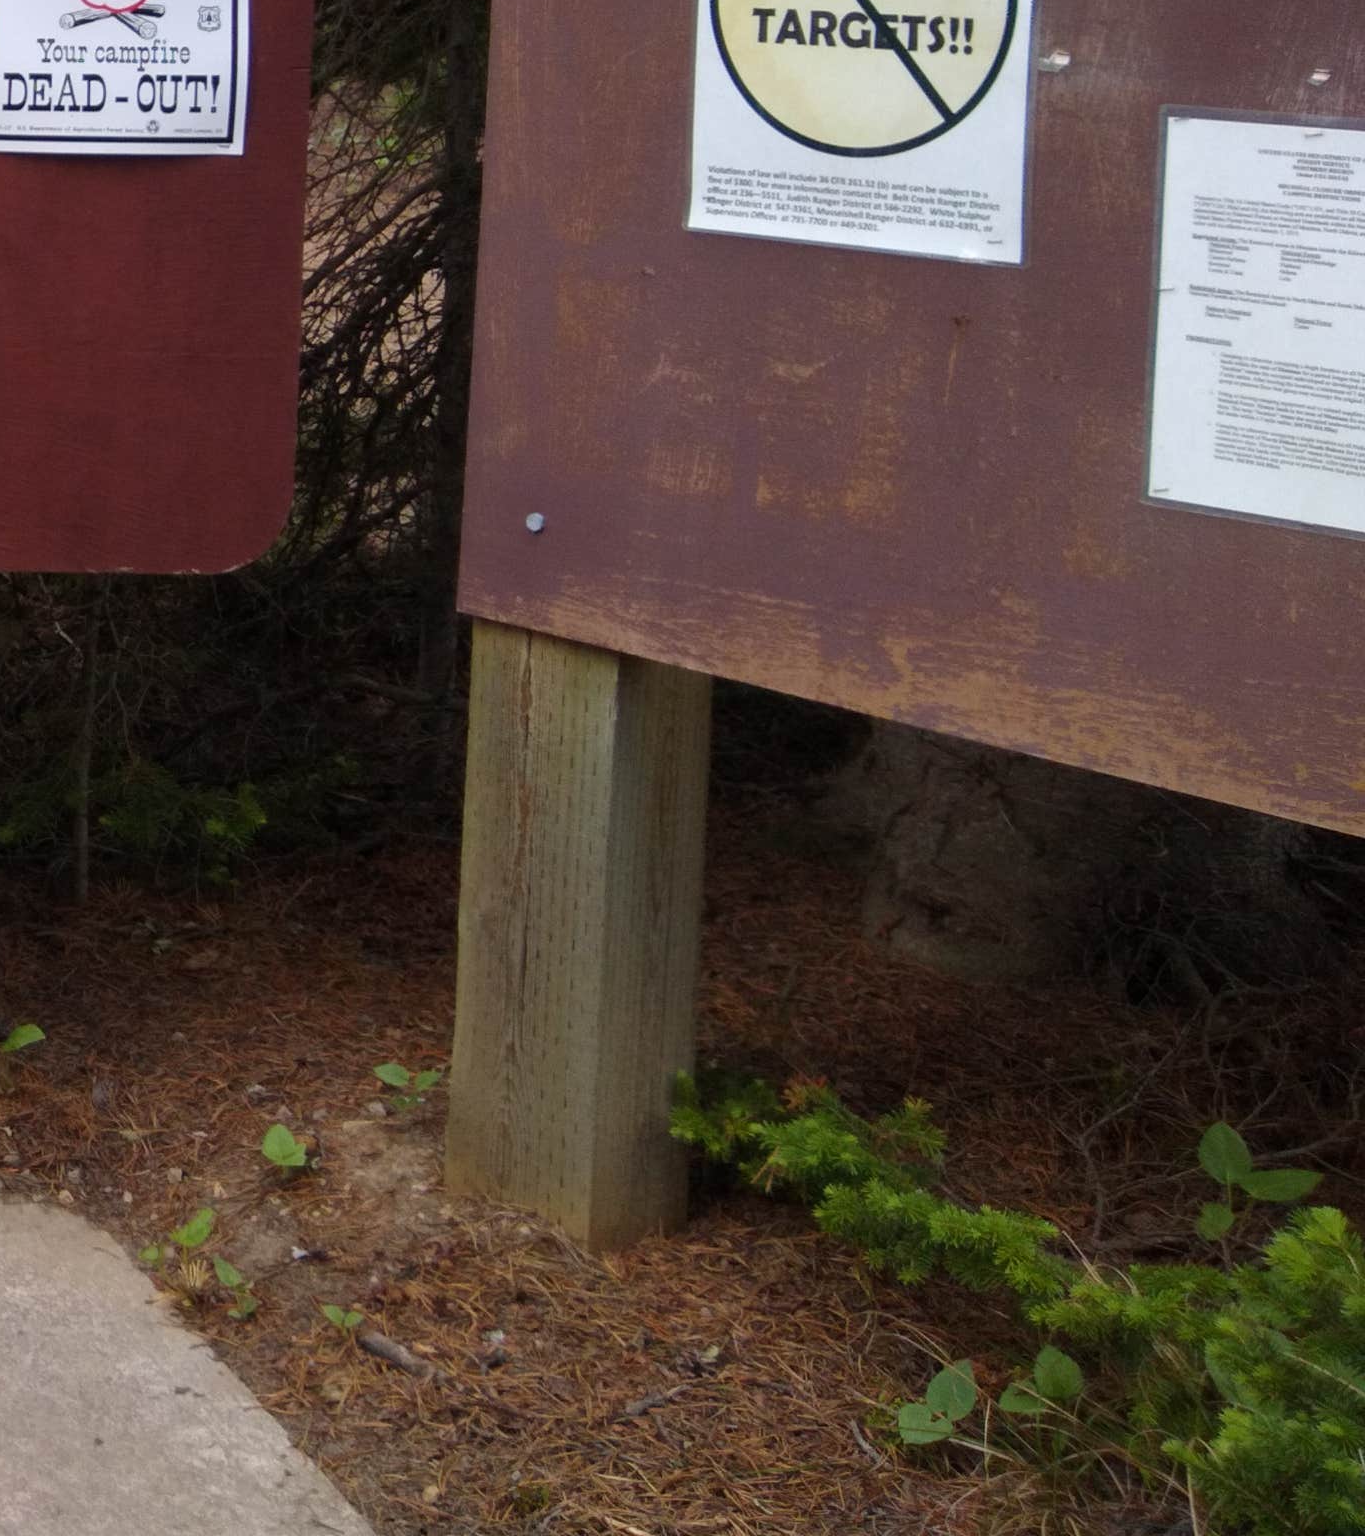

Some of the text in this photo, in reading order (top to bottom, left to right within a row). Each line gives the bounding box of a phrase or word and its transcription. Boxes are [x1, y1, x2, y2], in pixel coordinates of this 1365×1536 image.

[752, 8, 974, 54] TARGETS!!
[37, 37, 189, 71] Your campfire
[2, 73, 106, 112] DEAD
[137, 75, 219, 113] OUT!
